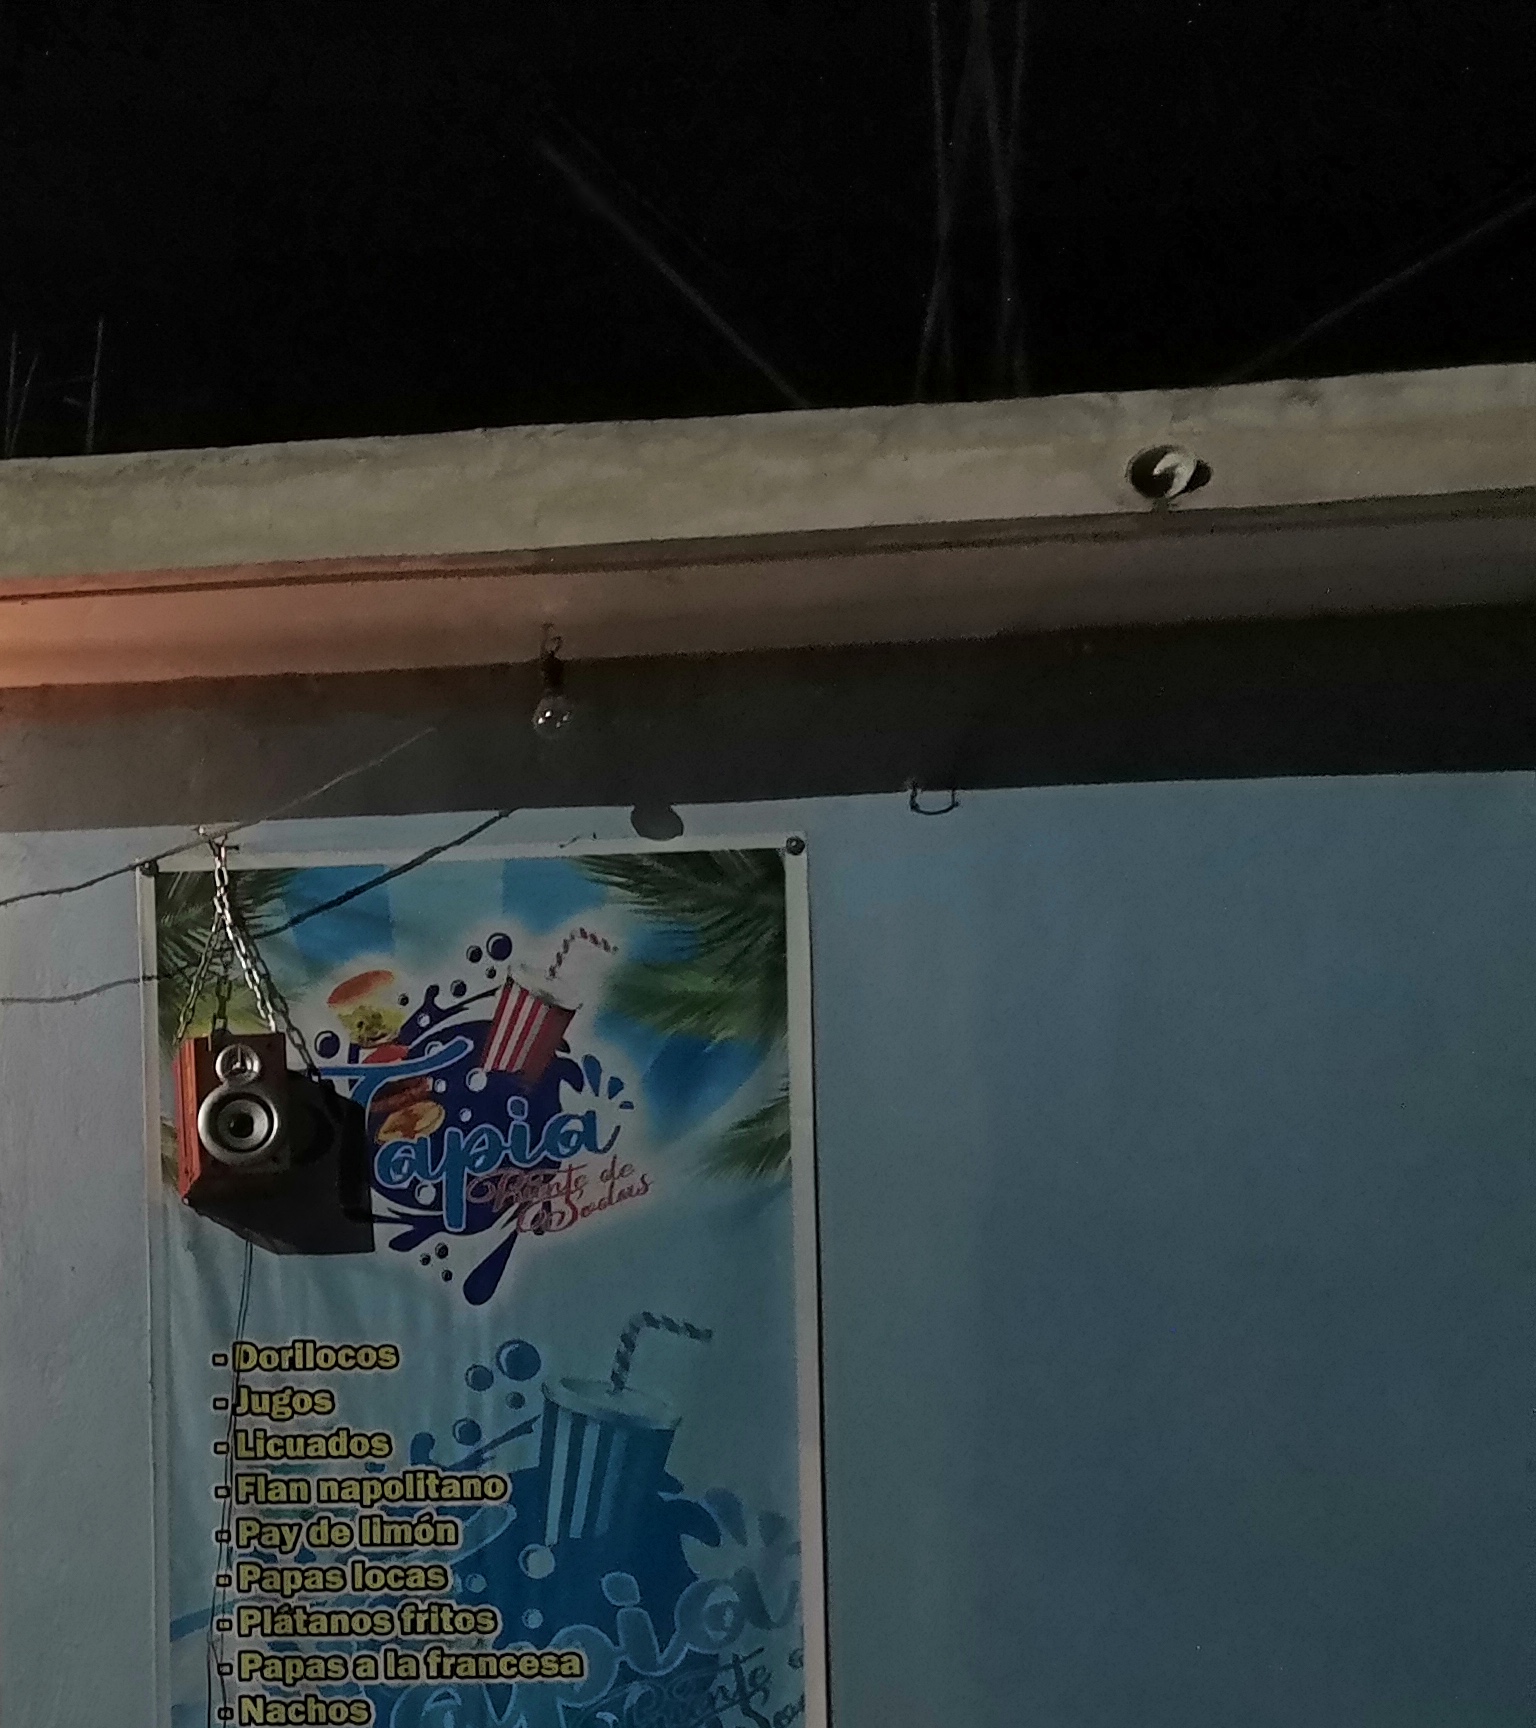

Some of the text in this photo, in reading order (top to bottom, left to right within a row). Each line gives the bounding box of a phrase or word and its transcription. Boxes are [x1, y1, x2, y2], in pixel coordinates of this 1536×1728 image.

[599, 1154, 637, 1186] de
[232, 1339, 400, 1373] Dorilocos
[235, 1386, 336, 1421] Jugos
[234, 1427, 394, 1461] Licuados
[236, 1469, 509, 1508] Flan napolitano
[236, 1512, 459, 1553] Pay de limón
[237, 1558, 449, 1597] Papas locas
[237, 1601, 499, 1638] Plátanos fritos
[237, 1646, 585, 1687] Papas a la francesa
[237, 1693, 372, 1727] Nachos
